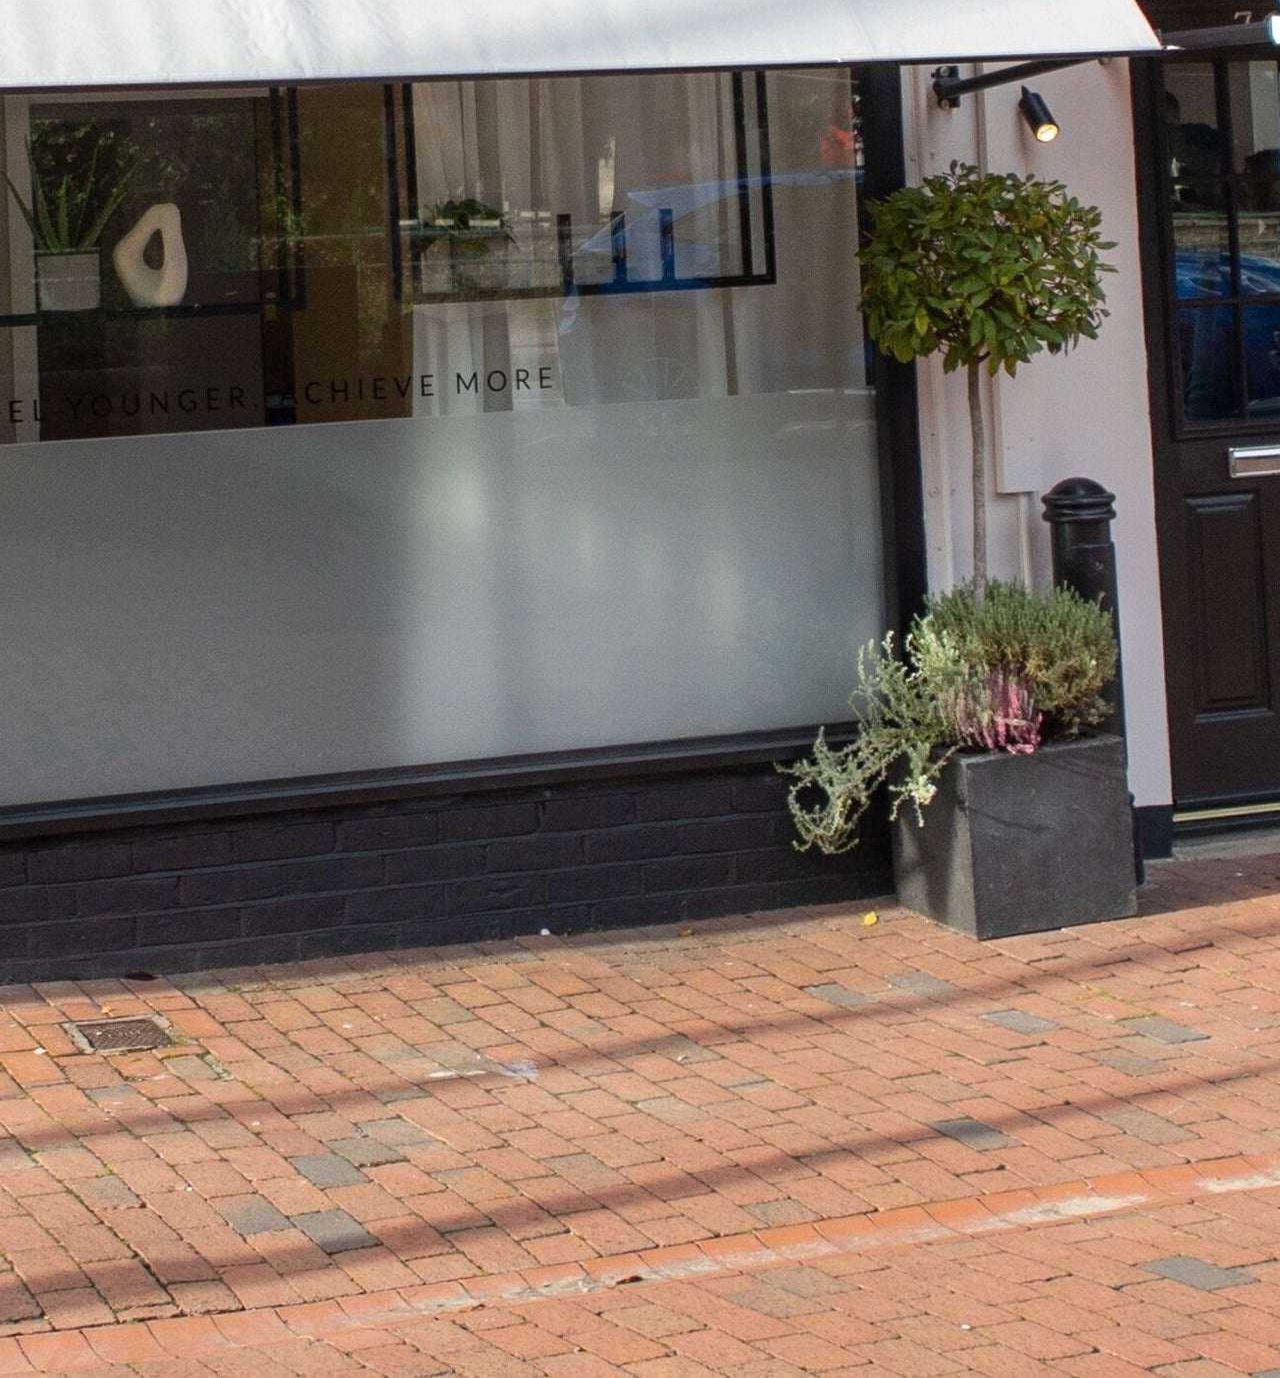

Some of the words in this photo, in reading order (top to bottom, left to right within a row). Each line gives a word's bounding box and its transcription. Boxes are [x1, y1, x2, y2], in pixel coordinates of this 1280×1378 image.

[64, 386, 259, 418] YOUNGER,
[280, 374, 434, 405] ACHIEVE
[456, 366, 553, 395] MORE
